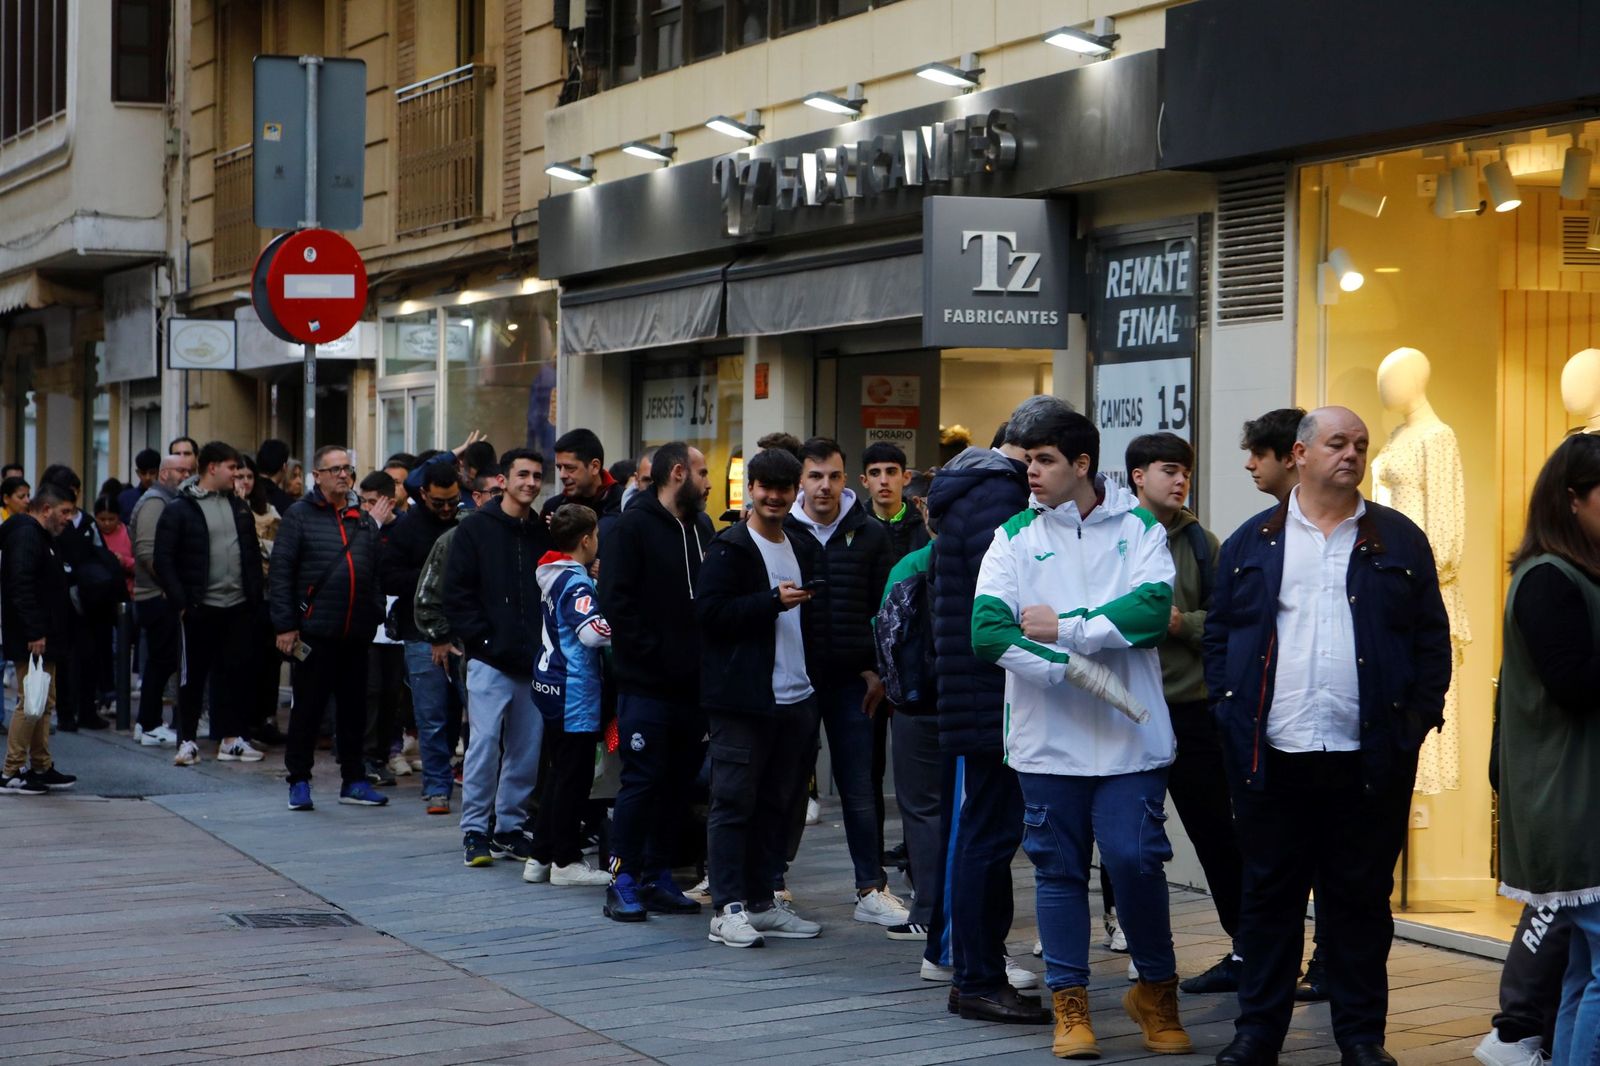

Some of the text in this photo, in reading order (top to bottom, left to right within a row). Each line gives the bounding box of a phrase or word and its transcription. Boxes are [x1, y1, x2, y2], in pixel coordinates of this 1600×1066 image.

[1105, 251, 1191, 299] REMATE
[943, 308, 1059, 325] FABRICANTES
[1116, 304, 1179, 349] FINAL
[1100, 384, 1191, 430] CAMISAS 15
[869, 430, 913, 440] HORARIO
